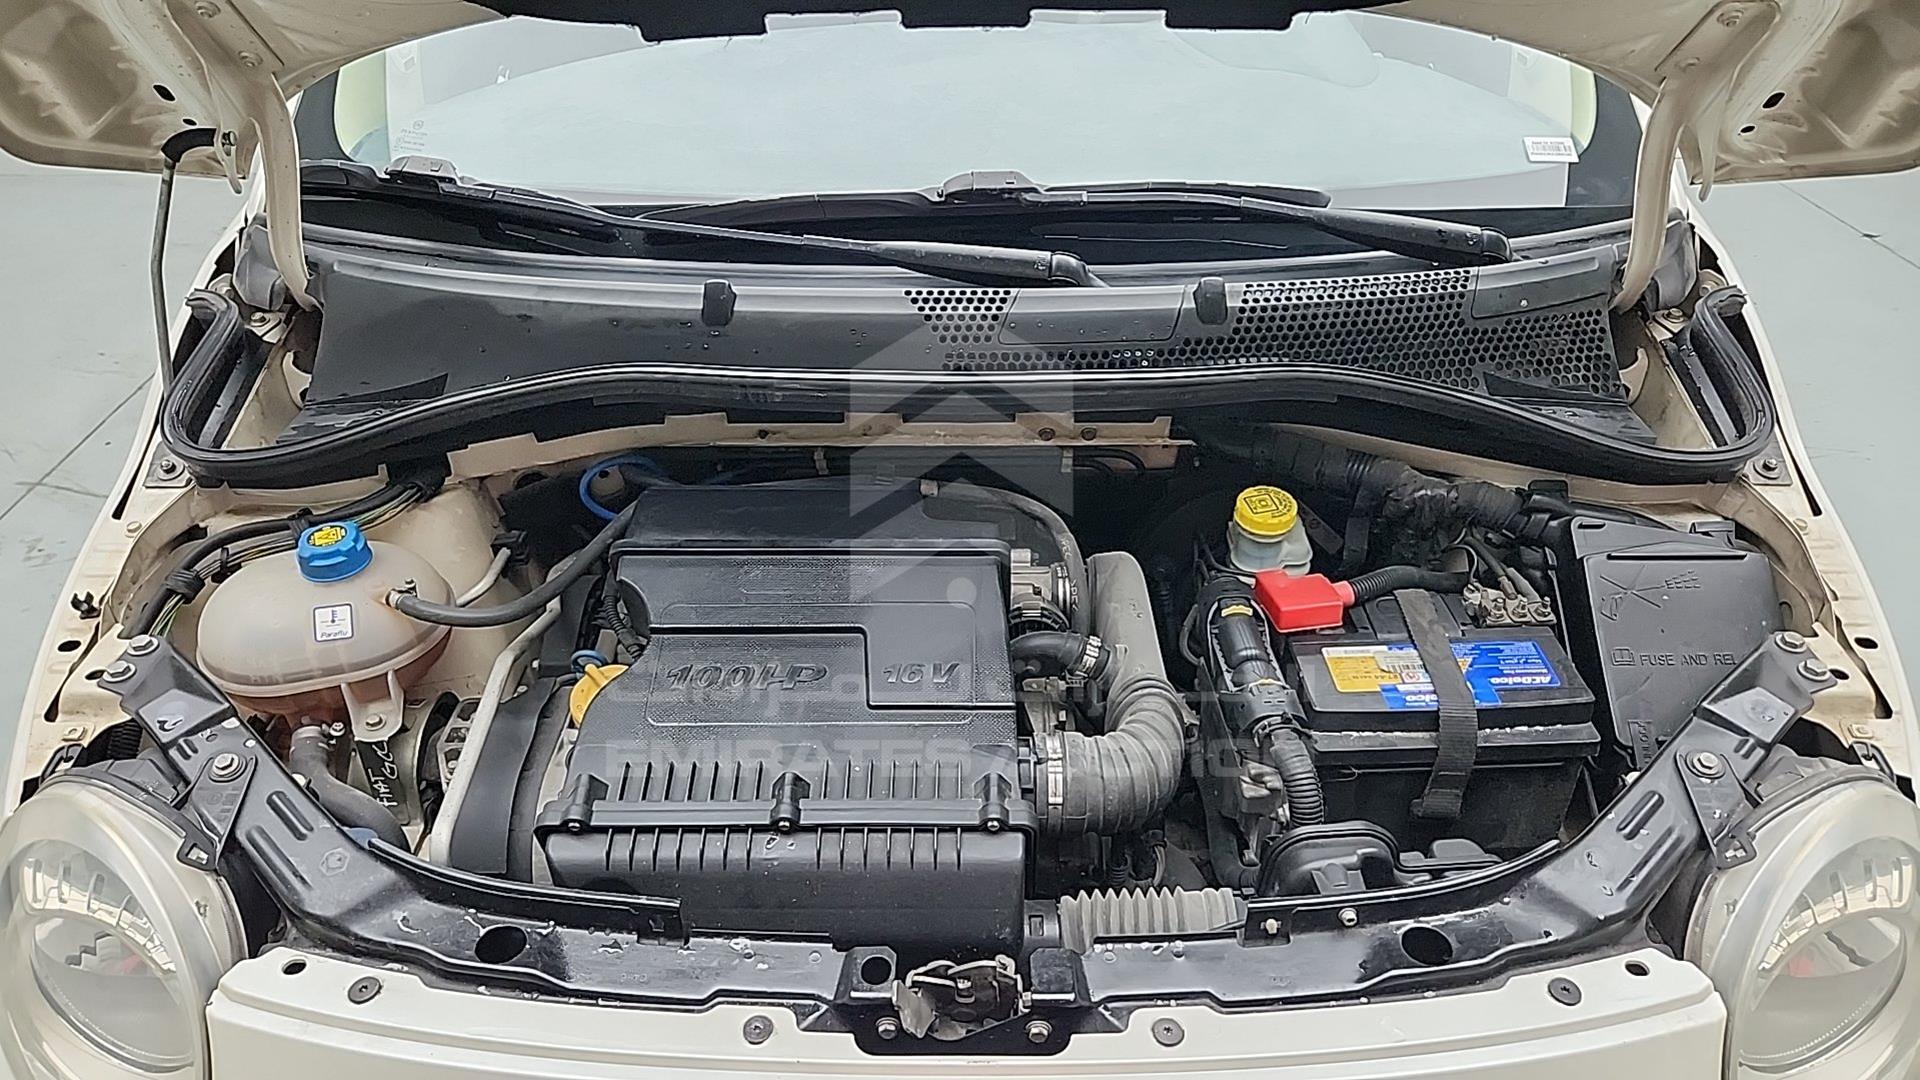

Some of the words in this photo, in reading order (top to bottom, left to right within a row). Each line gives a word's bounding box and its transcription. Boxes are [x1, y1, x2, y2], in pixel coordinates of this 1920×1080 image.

[1640, 653, 1675, 666] FUSE
[1681, 653, 1708, 666] AND
[1713, 653, 1738, 666] REL
[667, 663, 828, 691] 100HP
[1490, 676, 1552, 685] ACDelco
[368, 768, 398, 806] FIAT
